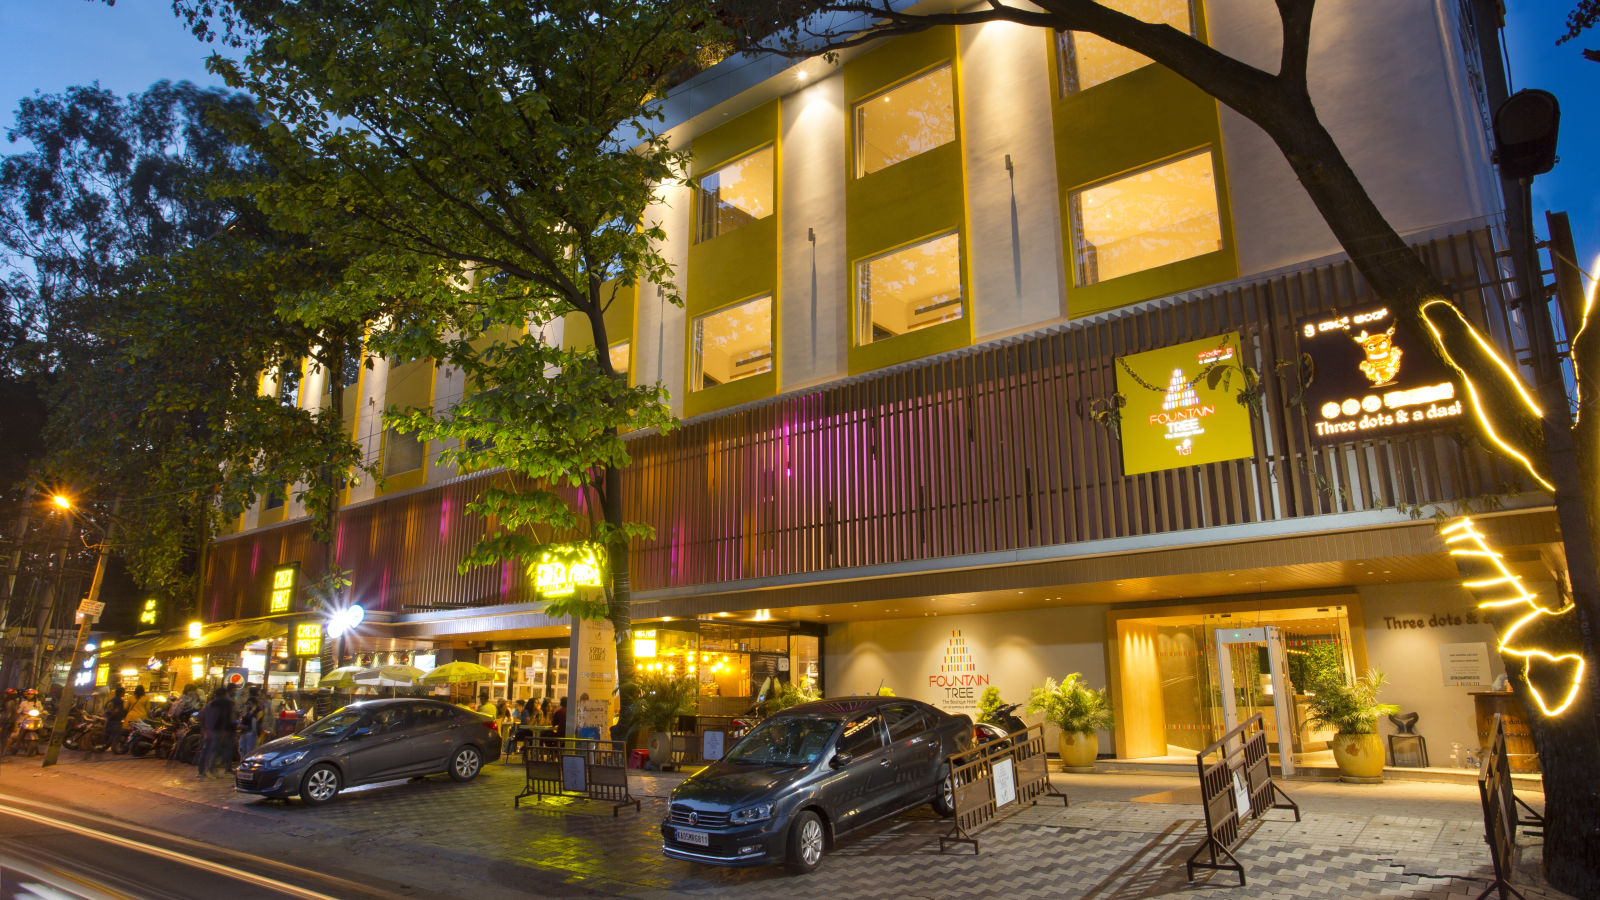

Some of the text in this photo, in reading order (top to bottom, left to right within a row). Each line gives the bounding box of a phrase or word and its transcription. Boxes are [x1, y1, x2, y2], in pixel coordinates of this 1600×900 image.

[1149, 405, 1215, 426] FOUNTAIN
[1315, 421, 1356, 436] Three
[1359, 413, 1393, 430] dots
[1396, 409, 1409, 423] &
[1412, 409, 1424, 421] a
[1166, 418, 1199, 433] TREE
[1384, 616, 1425, 630] Three
[1428, 613, 1462, 628] dots
[297, 624, 322, 638] CHECK
[296, 638, 320, 655] POST
[928, 674, 989, 687] FOUNTAIN
[945, 687, 974, 699] TREE
